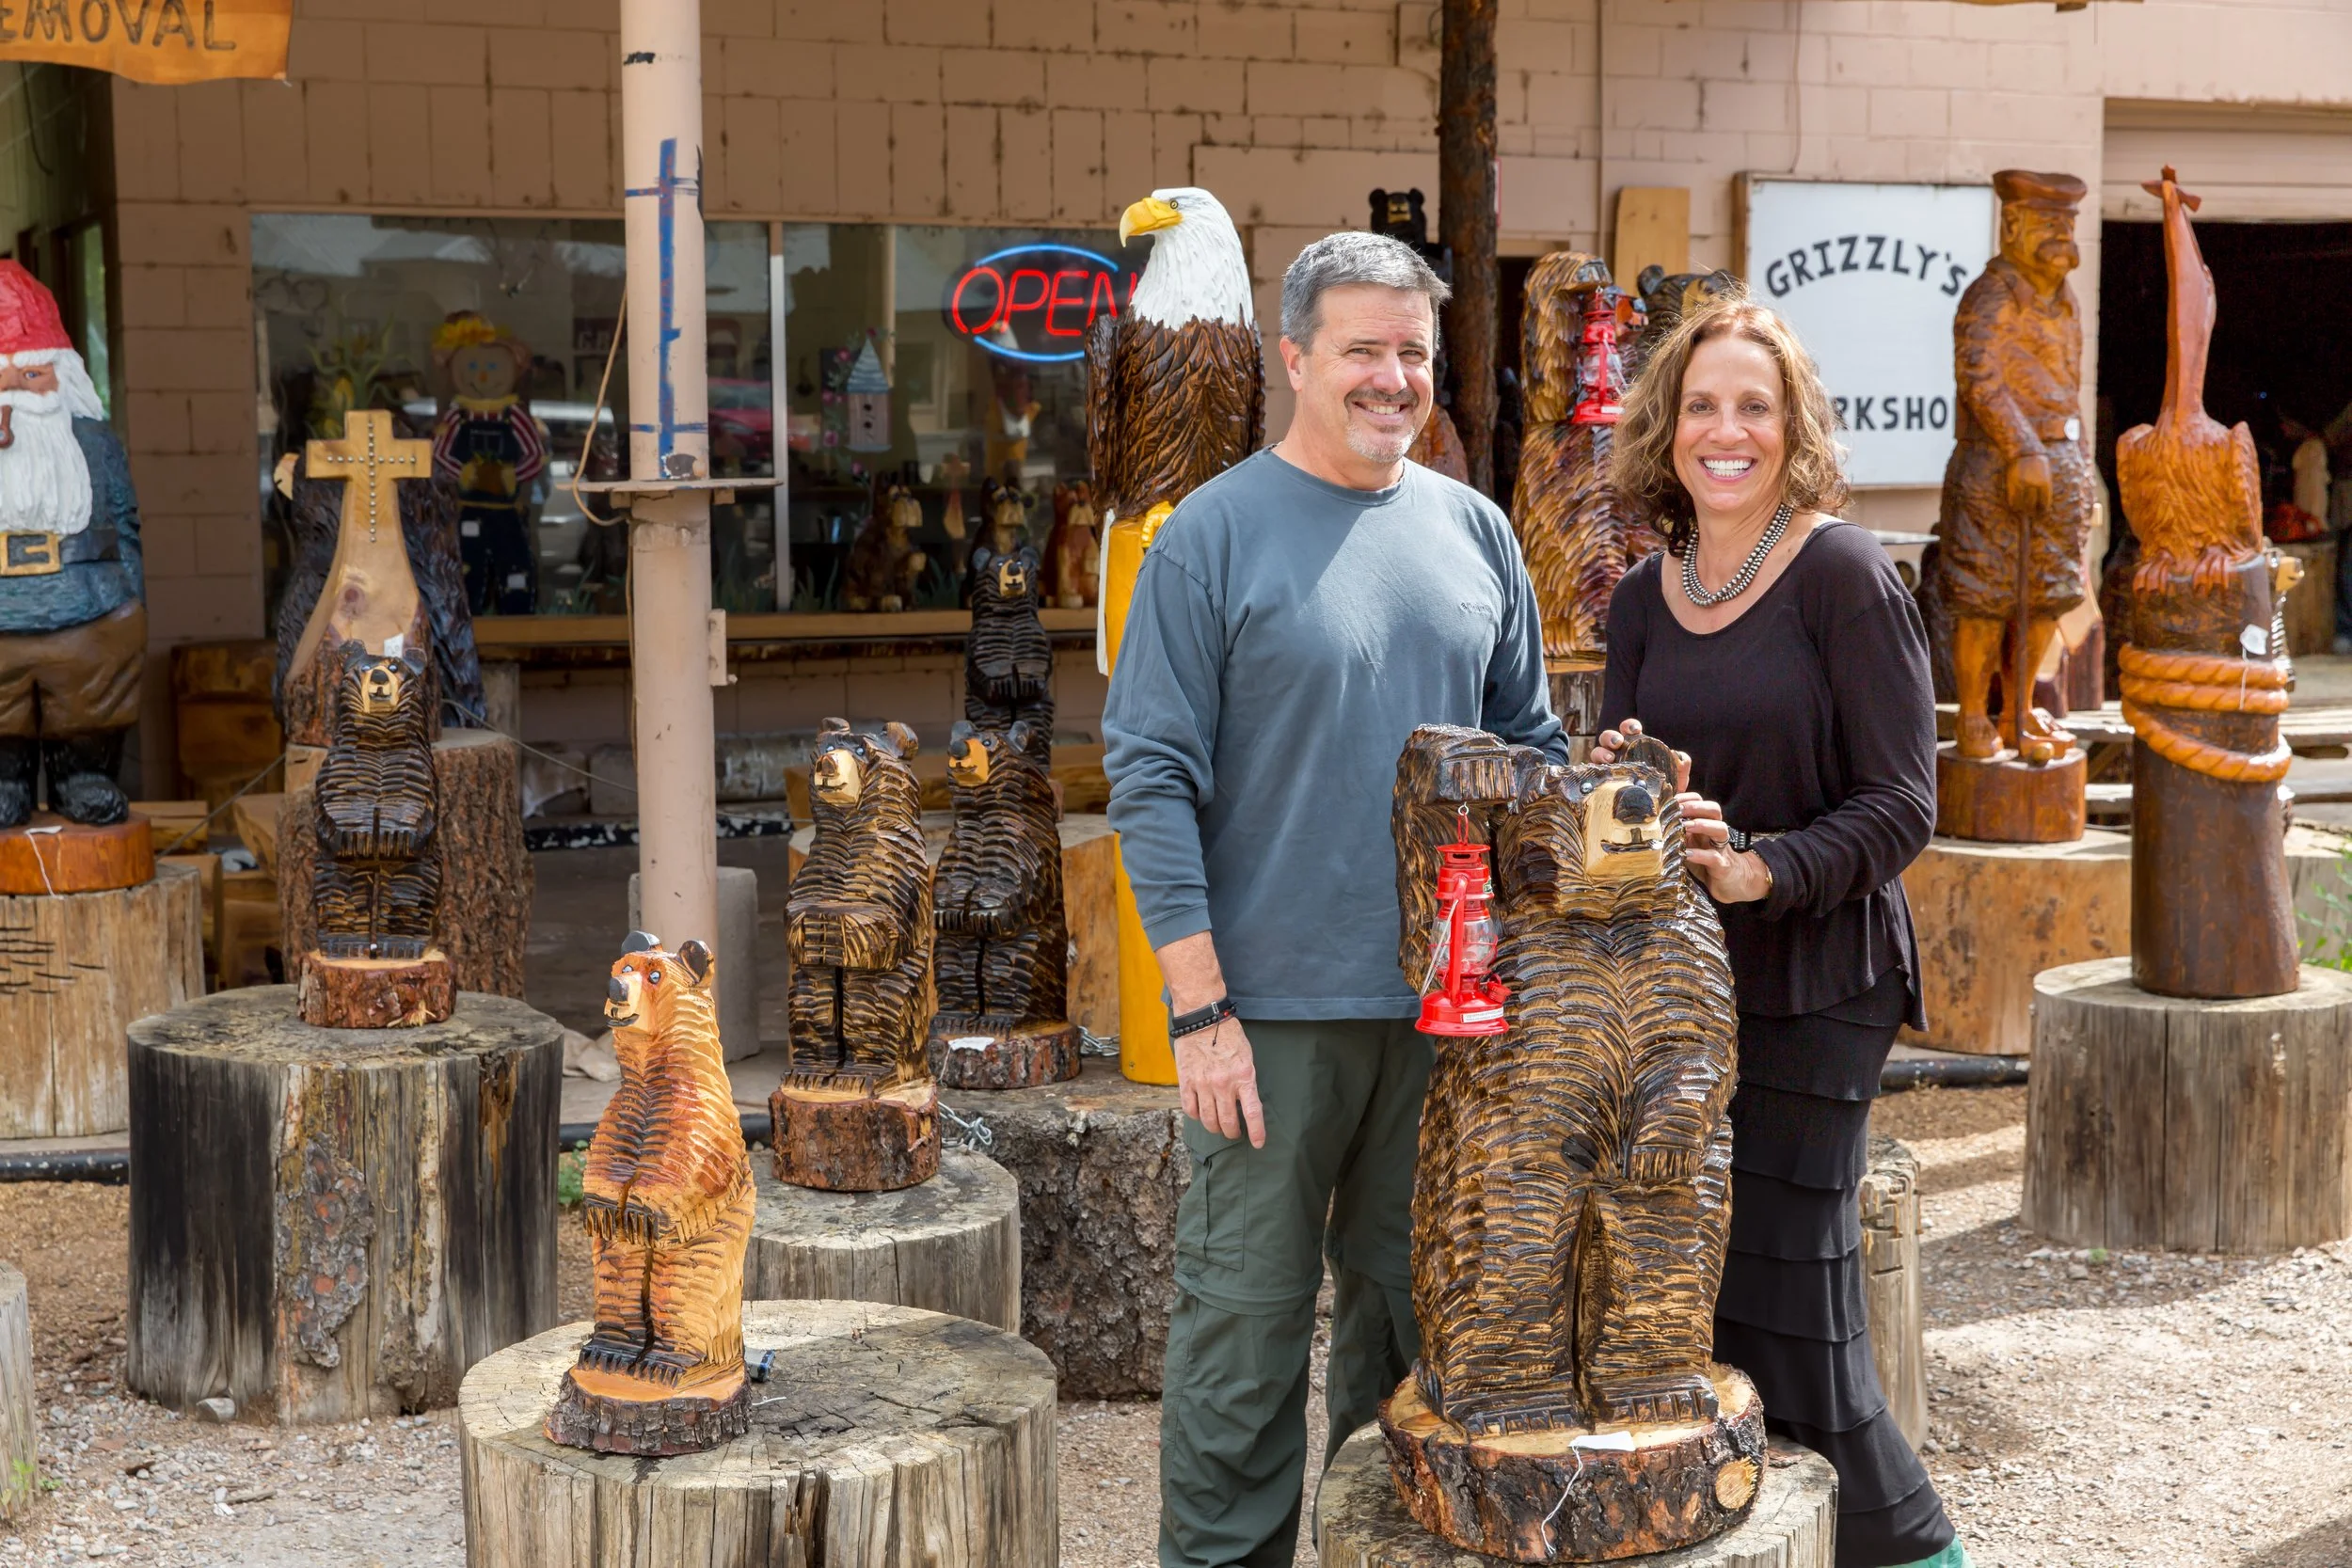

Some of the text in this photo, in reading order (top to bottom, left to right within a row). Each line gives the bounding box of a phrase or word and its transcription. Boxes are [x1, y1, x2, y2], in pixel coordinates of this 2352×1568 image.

[0, 0, 236, 50] EMOVAL
[1766, 235, 1968, 298] GRIZZLY'S
[952, 266, 1136, 336] OPEN
[1832, 396, 1948, 431] RKSHO
